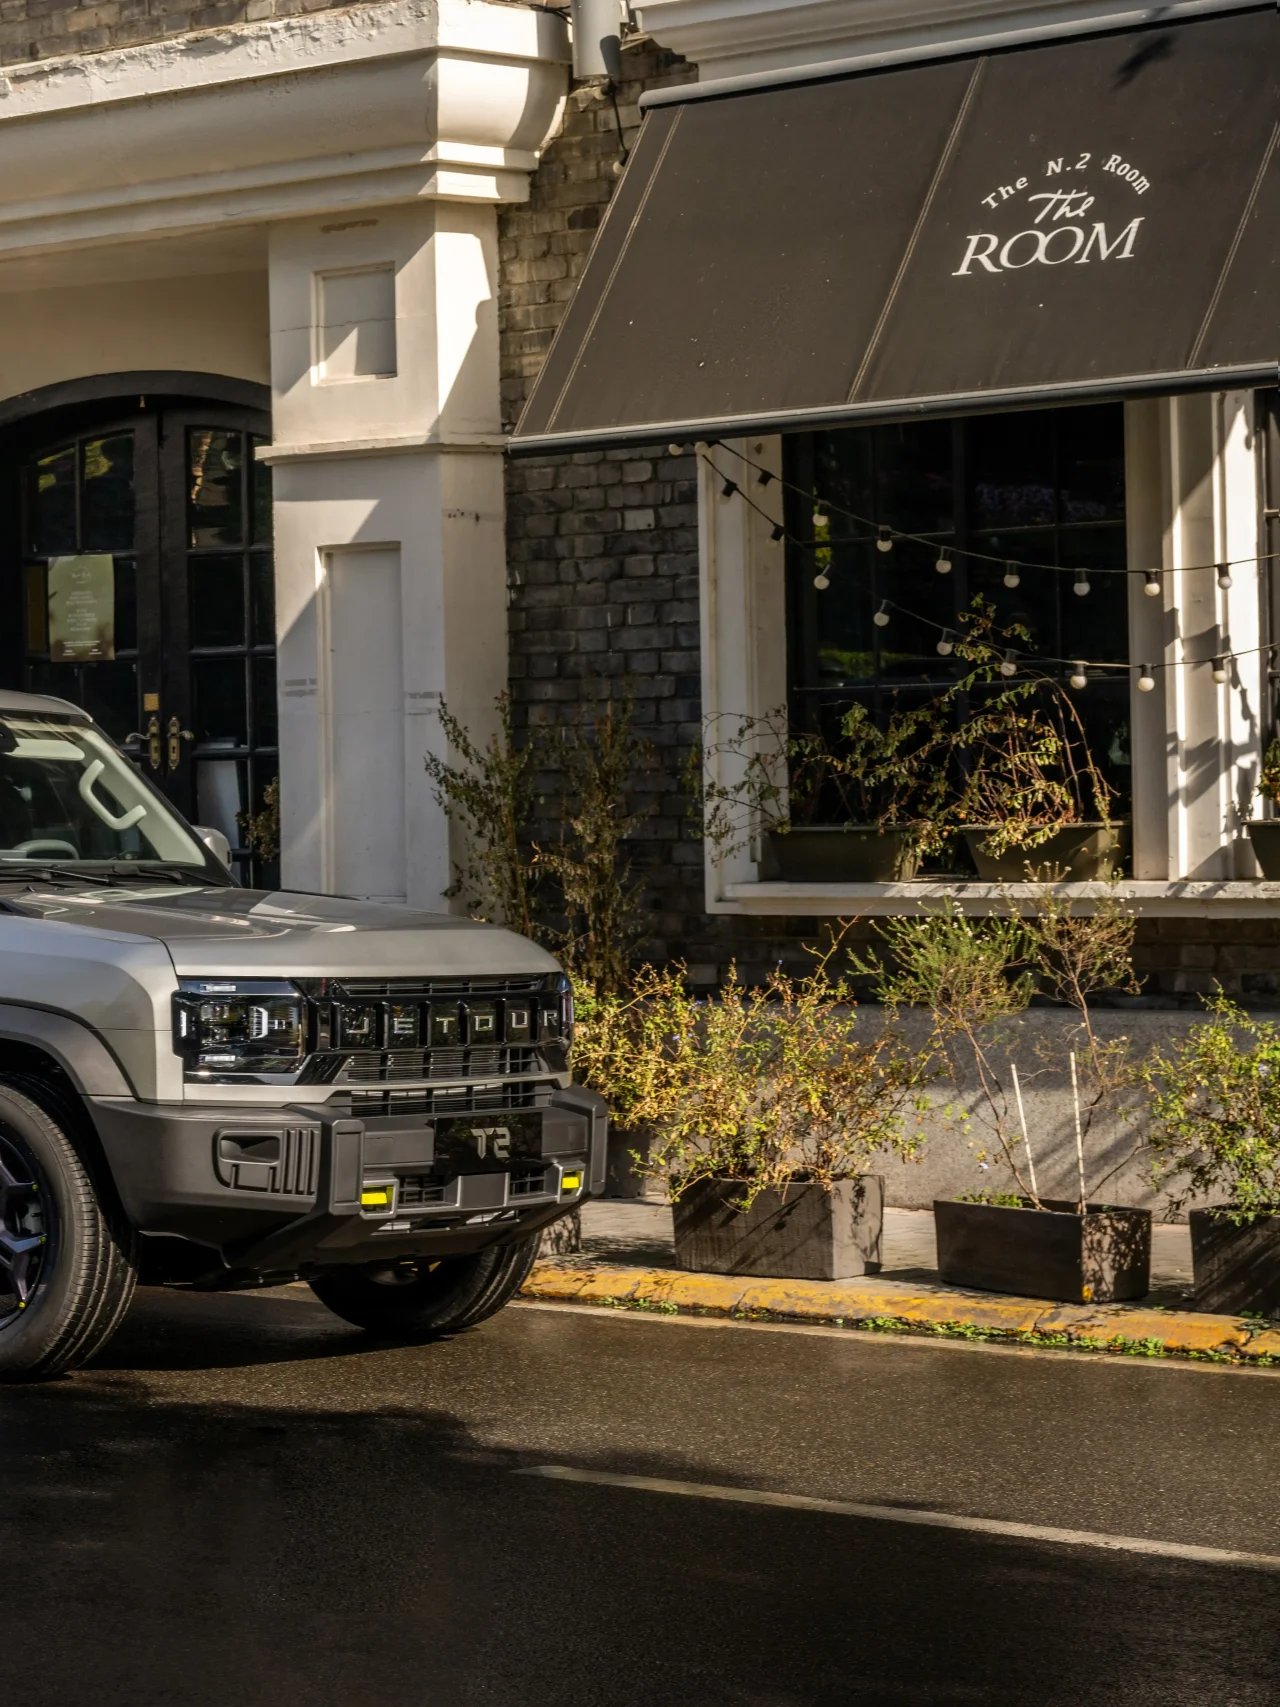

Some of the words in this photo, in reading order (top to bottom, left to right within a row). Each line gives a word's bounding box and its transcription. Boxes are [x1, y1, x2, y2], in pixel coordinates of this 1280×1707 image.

[981, 176, 1029, 209] The
[1045, 152, 1091, 176] N.2
[1102, 154, 1151, 195] Room
[1027, 189, 1095, 224] The
[951, 217, 1146, 276] ROOM
[345, 1009, 559, 1035] JETOUR
[470, 1126, 511, 1159] T2
